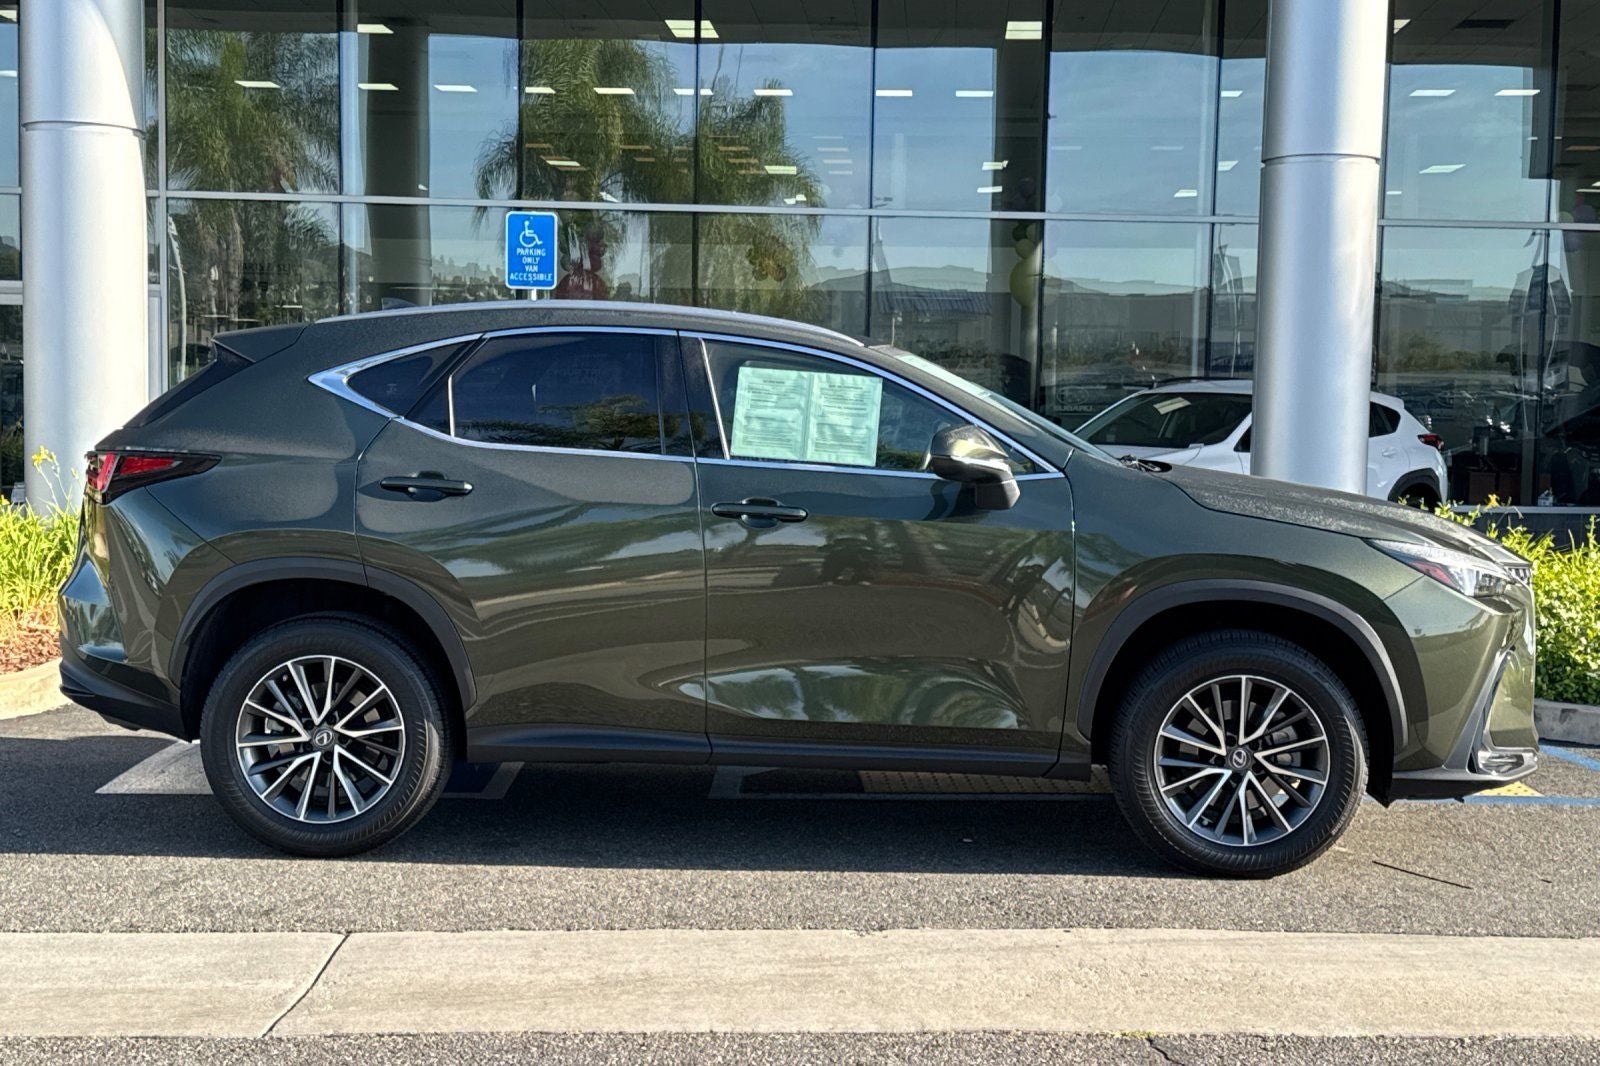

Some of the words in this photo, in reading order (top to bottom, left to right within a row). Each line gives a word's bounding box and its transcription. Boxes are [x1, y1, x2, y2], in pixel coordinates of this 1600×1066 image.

[516, 248, 546, 256] PARKING
[522, 256, 540, 264] ONLY
[509, 272, 552, 281] ACCESSIBLE
